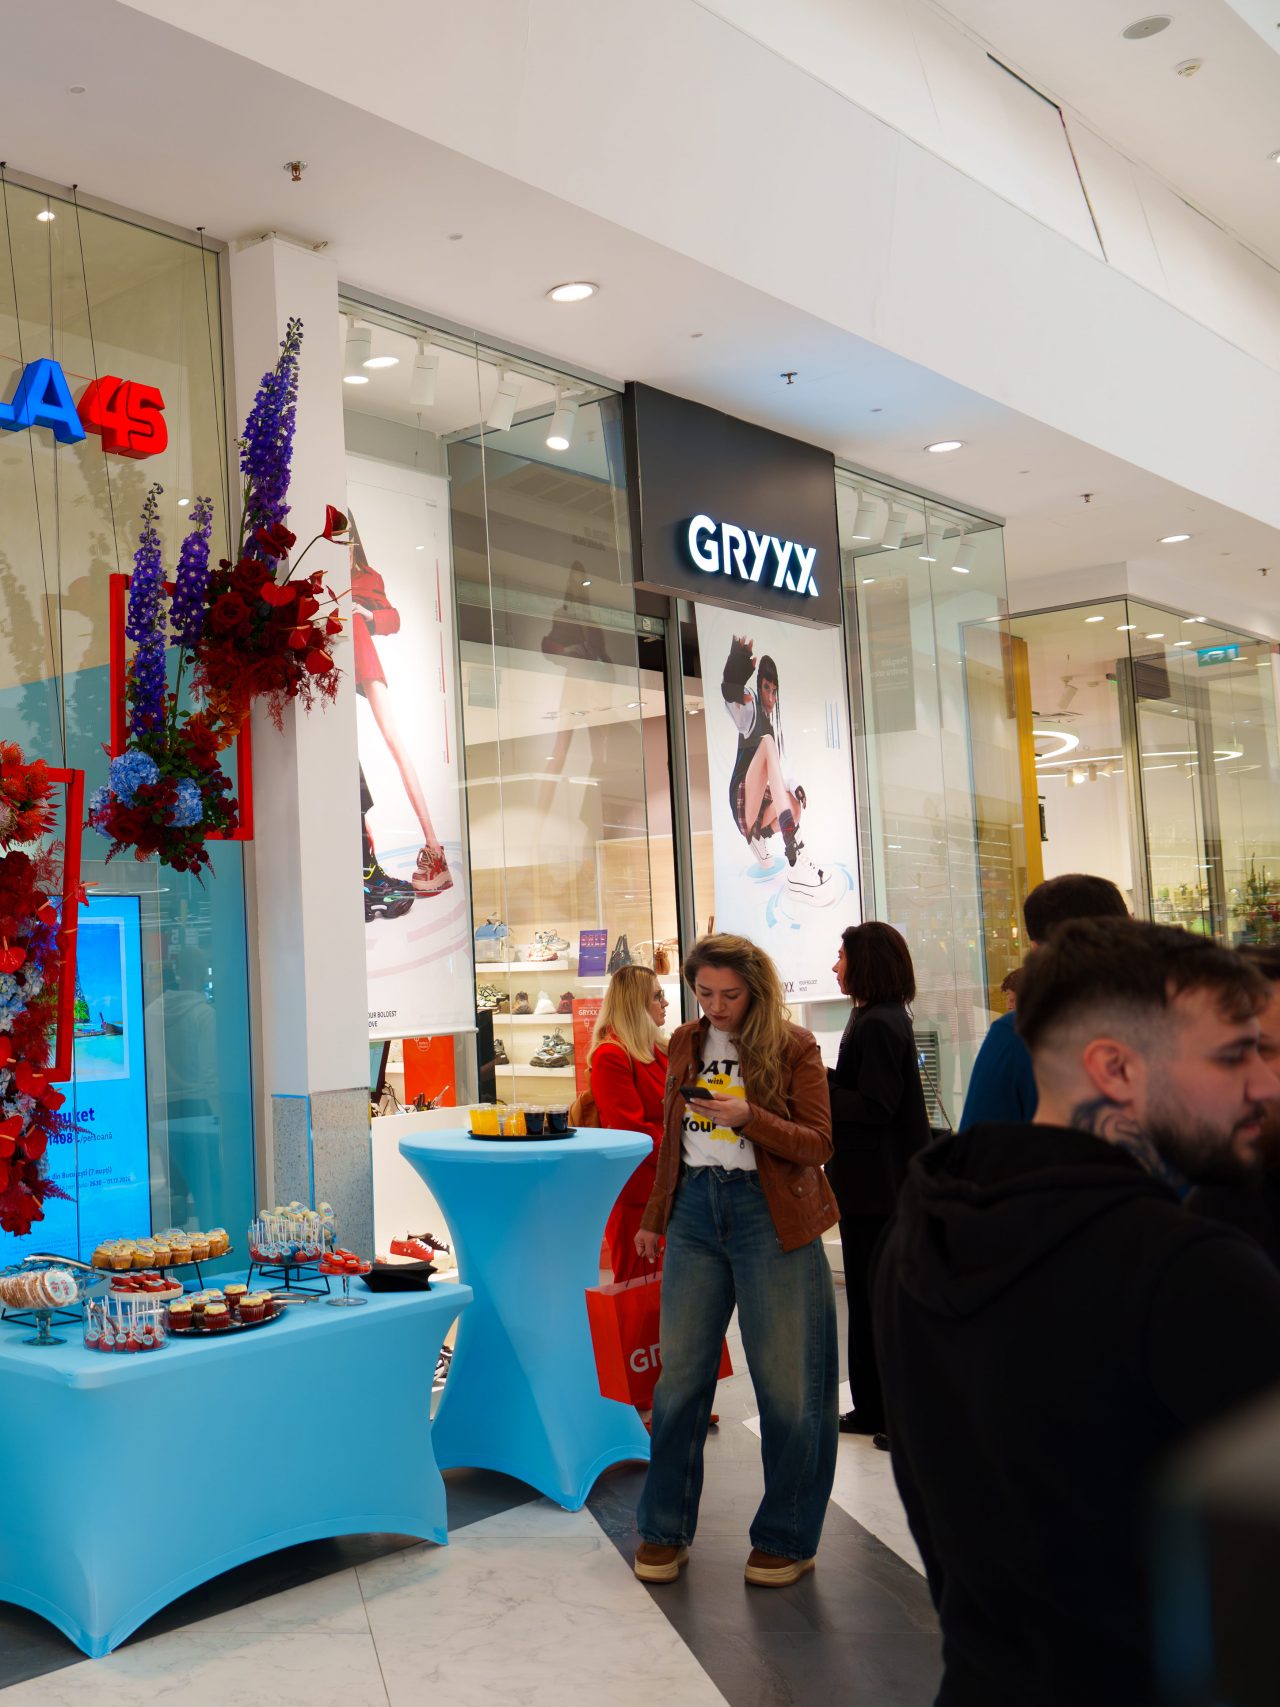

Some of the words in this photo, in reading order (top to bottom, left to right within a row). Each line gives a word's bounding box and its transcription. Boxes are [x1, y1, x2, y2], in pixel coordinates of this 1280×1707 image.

[76, 374, 168, 460] 45
[687, 514, 818, 597] GRYXX
[581, 933, 606, 947] SALE
[377, 1010, 397, 1018] BOLDEST
